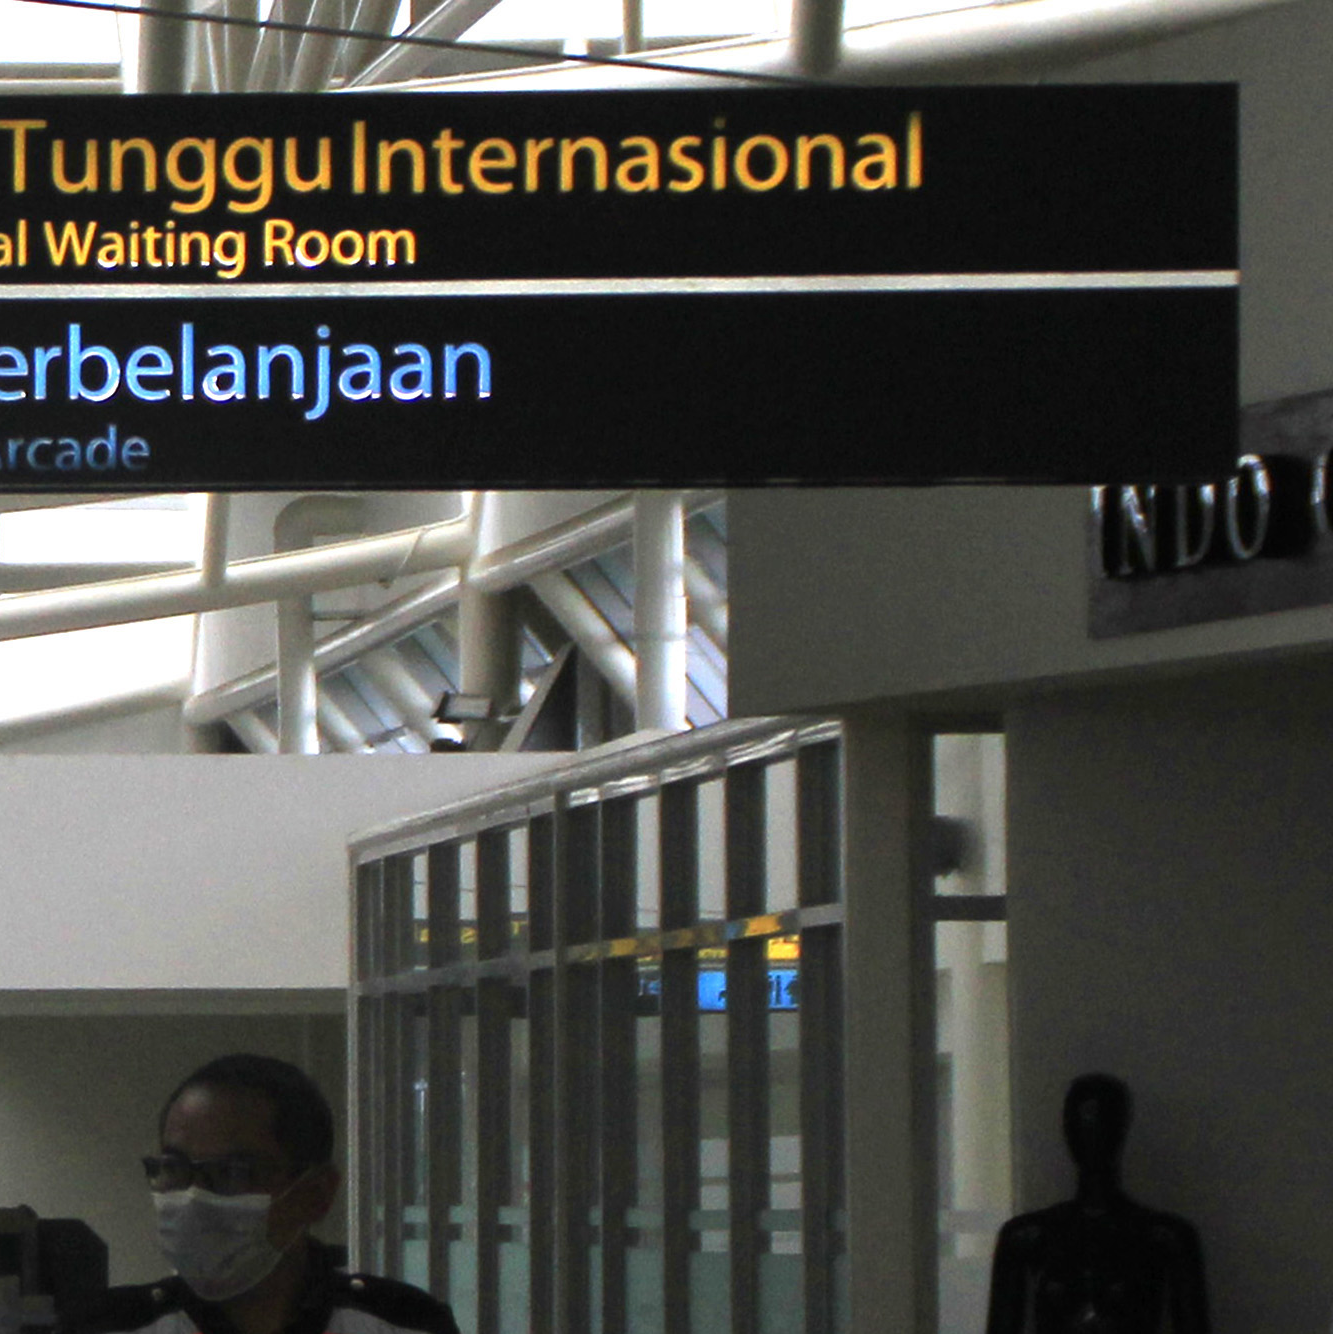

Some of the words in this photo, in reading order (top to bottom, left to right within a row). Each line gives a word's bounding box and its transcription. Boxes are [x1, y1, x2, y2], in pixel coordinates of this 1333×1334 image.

[352, 113, 922, 194] Internasional
[43, 220, 247, 278] Waiting
[263, 219, 417, 267] Room
